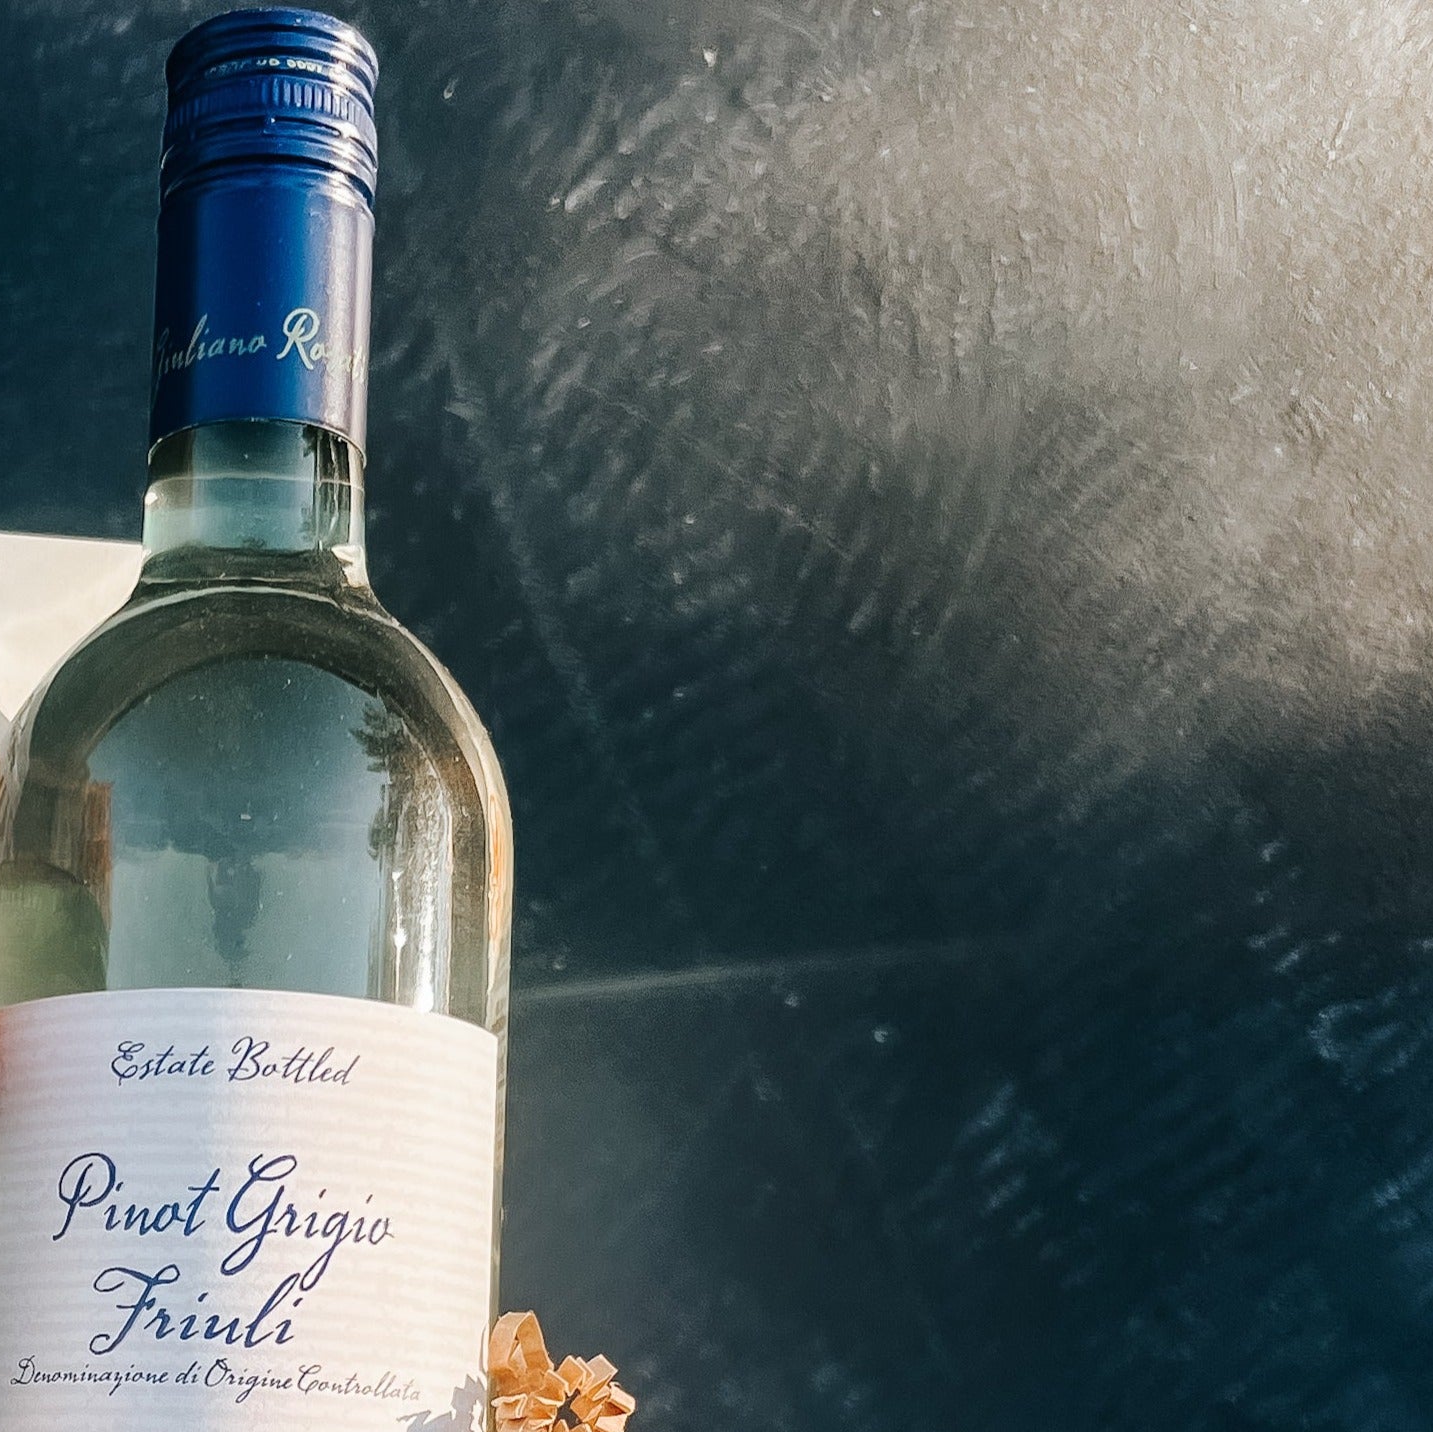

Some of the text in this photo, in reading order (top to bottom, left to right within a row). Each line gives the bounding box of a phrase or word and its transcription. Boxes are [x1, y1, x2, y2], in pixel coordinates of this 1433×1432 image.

[111, 1036, 359, 1086] Estate Bottled
[52, 1152, 395, 1290] Pinot Grigio
[89, 1263, 304, 1356] Friuli
[11, 1355, 421, 1403] Denominazione di Origine Controllata
